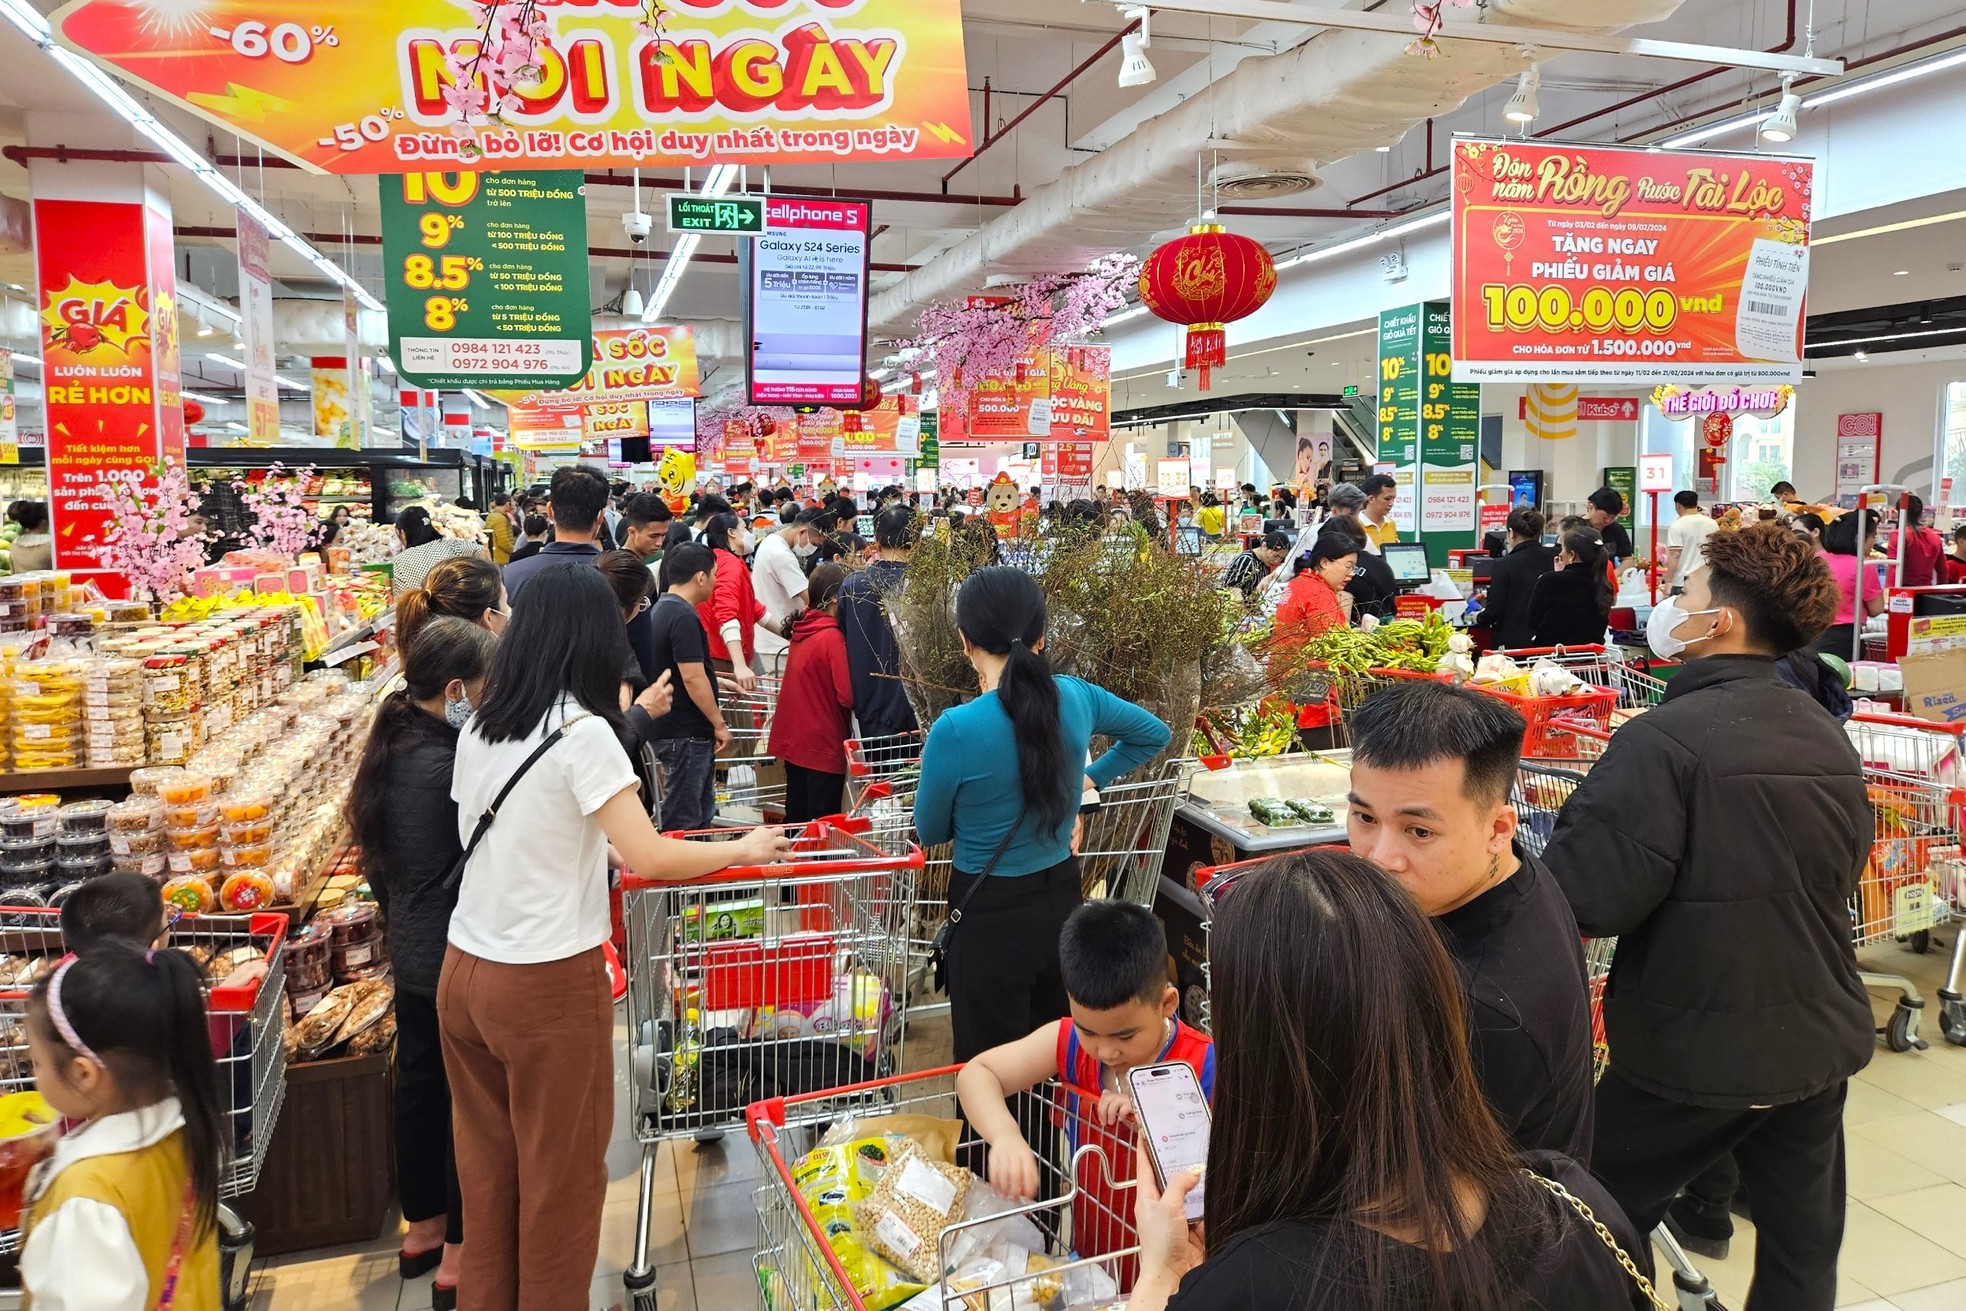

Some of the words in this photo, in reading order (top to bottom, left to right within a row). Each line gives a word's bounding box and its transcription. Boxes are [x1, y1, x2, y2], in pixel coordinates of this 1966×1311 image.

[208, 21, 339, 62] -60%
[639, 21, 898, 113] NGÀY
[316, 105, 405, 152] -50%
[485, 128, 520, 152] bỏ
[529, 132, 560, 151] lỡ!
[569, 133, 603, 150] Cơ
[612, 132, 653, 155] hội
[661, 131, 709, 152] duy
[717, 126, 774, 149] nhất
[781, 129, 849, 150] trong
[857, 125, 916, 149] ngày
[1493, 153, 1532, 180] Đón
[517, 178, 536, 186] hàng
[1492, 179, 1535, 201] năm
[1537, 155, 1631, 219] Rồng
[486, 188, 497, 197] từ
[498, 189, 516, 197] 500
[518, 190, 544, 199] TRIỆU
[546, 189, 574, 199] ĐỒNG
[1638, 176, 1681, 202] Rước
[1683, 168, 1729, 210] Tài
[1726, 170, 1784, 220] Lộc
[487, 199, 499, 207] trở
[679, 203, 690, 212] LỐI
[691, 203, 715, 213] THOÁT
[683, 218, 711, 227] EXIT
[846, 210, 857, 224] S
[419, 212, 465, 249] 9%
[1547, 220, 1557, 228] Từ
[1557, 221, 1573, 230] ngày
[1596, 222, 1610, 230] đến
[1611, 223, 1627, 232] ngày
[1628, 224, 1667, 232] 09/02/2024
[760, 240, 802, 252] Galaxy
[804, 242, 822, 252] S24
[826, 242, 860, 253] Series
[1552, 232, 1603, 256] TẶNG
[1608, 238, 1658, 256] NGAY
[777, 254, 802, 263] Galaxy
[1755, 255, 1772, 267] PHIẾU
[1773, 259, 1787, 271] TÍNH
[1788, 261, 1801, 273] TIỀN
[404, 253, 484, 291] 8.5%
[1531, 256, 1588, 280] PHIẾU
[1592, 258, 1640, 280] GIẢM
[1644, 262, 1676, 282] GIÁ
[765, 278, 772, 288] 5
[59, 296, 132, 332] GIÁ
[424, 295, 469, 331] 8%
[1482, 283, 1679, 336] 100.000
[1384, 315, 1399, 328] CHIẾT
[1400, 313, 1416, 324] KHẤU
[1394, 328, 1406, 337] QUÀ
[1406, 325, 1416, 335] TẾT
[452, 343, 487, 354] 0984
[492, 344, 511, 354] 121
[515, 344, 540, 354] 423
[610, 333, 666, 359] SỐC
[1513, 345, 1532, 354] CHO
[1534, 344, 1554, 354] HÓA
[1555, 345, 1576, 355] ĐƠN
[1577, 344, 1590, 354] TỪ
[54, 365, 98, 378] LUÔN
[100, 365, 142, 378] LUÔN
[452, 358, 489, 369] 0972
[492, 359, 519, 369] 904
[523, 359, 548, 370] 976
[1488, 368, 1503, 376] giảm
[605, 362, 678, 389] NGÀY
[1064, 376, 1089, 394] Vàng
[1429, 383, 1445, 399] 9%
[49, 381, 86, 405] RẺ
[90, 386, 151, 406] HƠN
[1666, 391, 1691, 412] THẾ
[1691, 391, 1716, 411] GIỚI
[1719, 388, 1740, 410] ĐỒ
[1741, 391, 1777, 409] CHƠI
[1050, 396, 1067, 408] ỘC
[1069, 394, 1103, 412] VÀNG
[1072, 412, 1094, 426] ĐÃI
[1422, 403, 1450, 420] 8.5%
[1428, 424, 1444, 440] 8%
[1840, 414, 1876, 436] GO!
[66, 444, 88, 453] Tiết
[91, 444, 117, 454] kiệm
[52, 455, 73, 464] mỗi
[76, 456, 102, 465] ngày
[106, 456, 132, 465] cùng
[135, 456, 155, 464] GO!
[63, 473, 92, 482] Trên
[96, 469, 145, 482] 1.000
[54, 488, 76, 496] sản
[64, 501, 89, 510] đến
